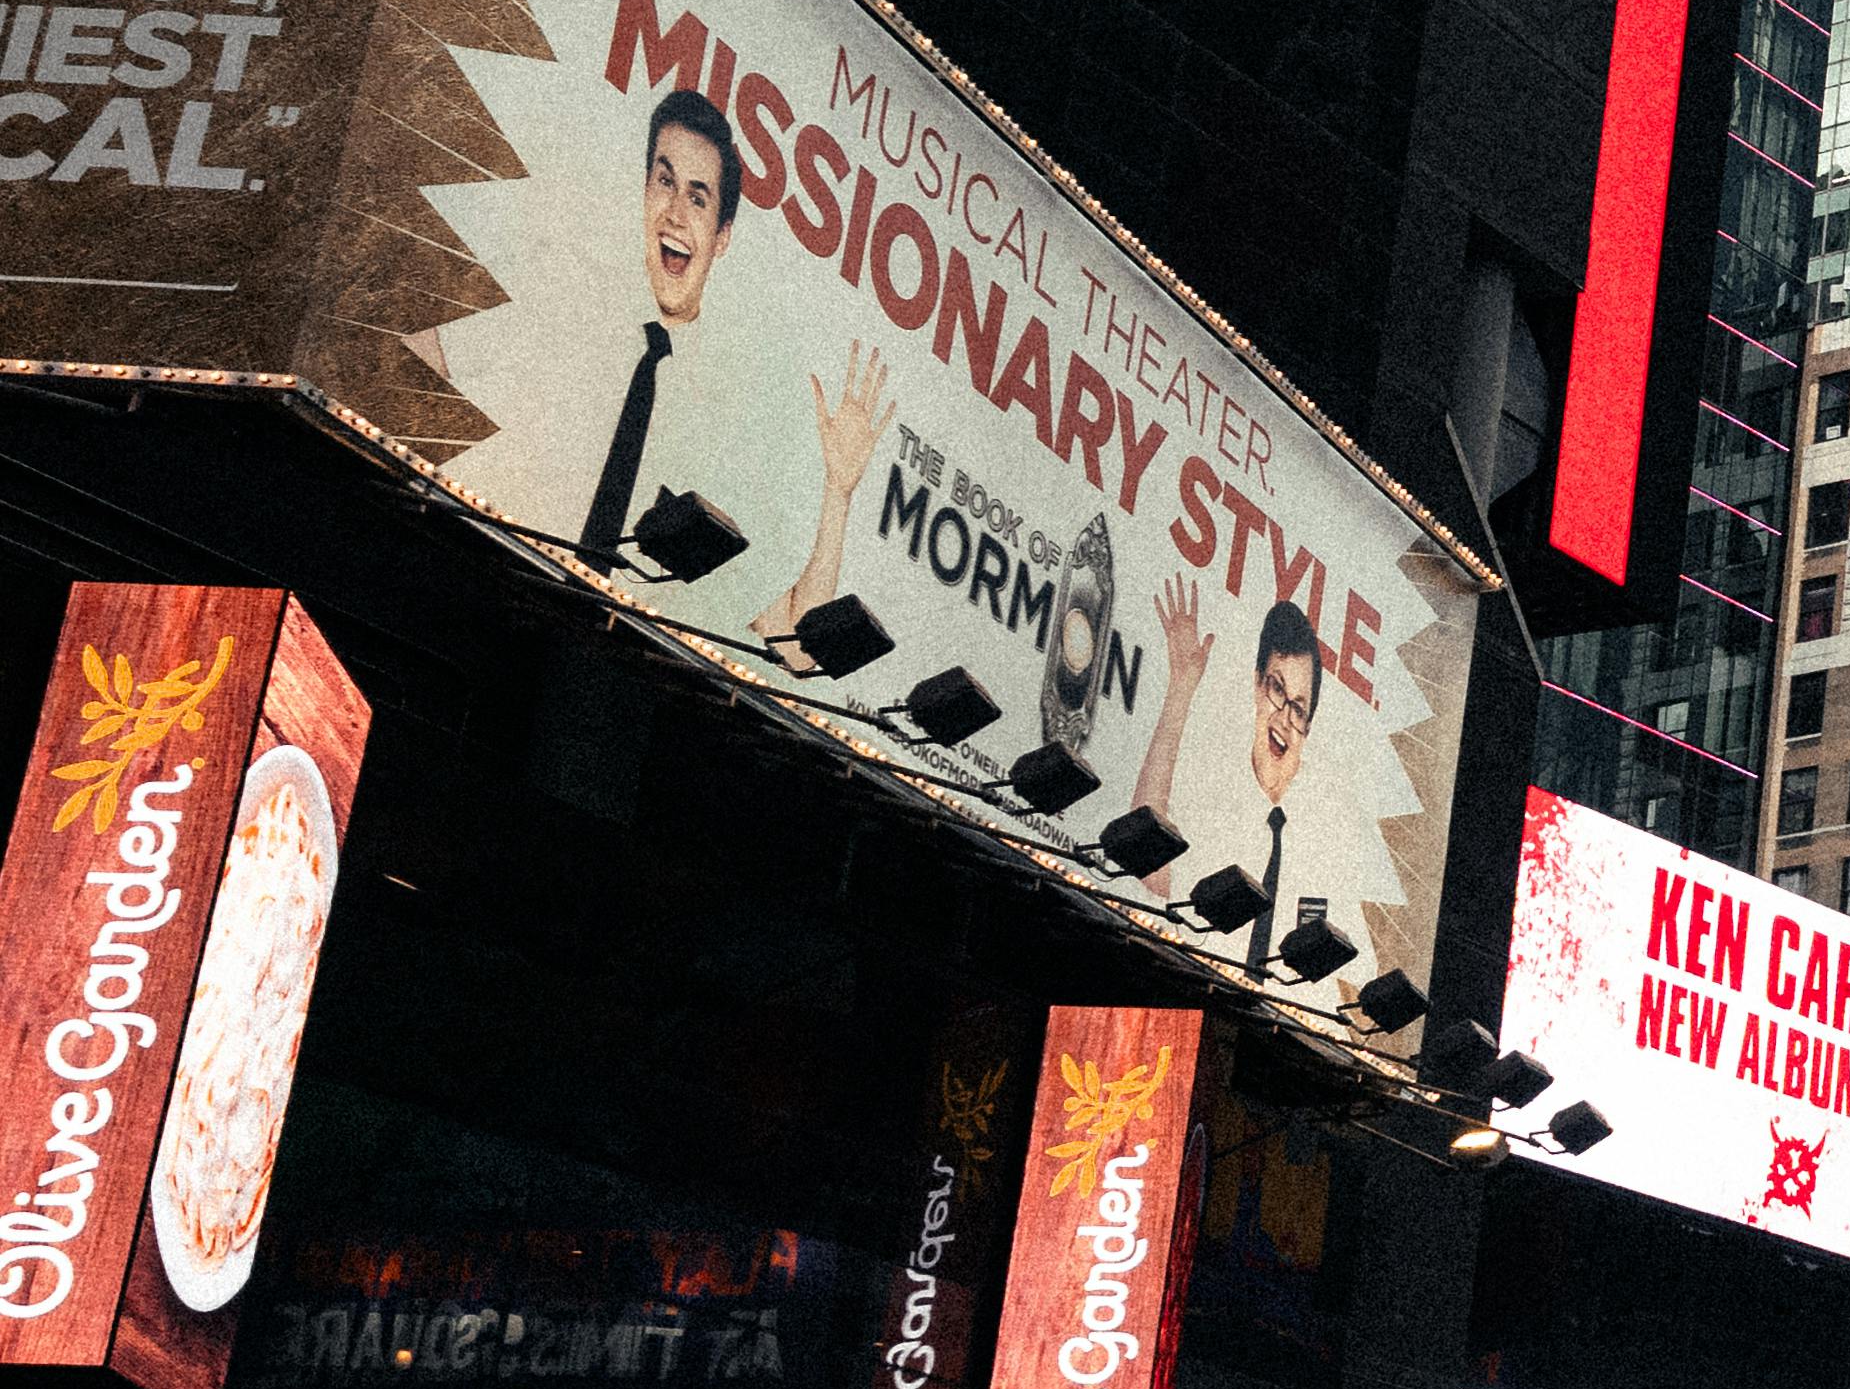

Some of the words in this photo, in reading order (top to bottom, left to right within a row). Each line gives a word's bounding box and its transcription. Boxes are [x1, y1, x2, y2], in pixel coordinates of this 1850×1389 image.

[0, 4, 283, 93] IEST
[830, 45, 1058, 309] MUSICAL
[1082, 266, 1276, 498] THEATER.
[899, 423, 946, 489] THE
[951, 468, 1023, 548] BOOK
[1028, 530, 1062, 571] OF
[46, 762, 195, 1080] Garden
[1646, 866, 1751, 992] KEN
[1635, 975, 1728, 1070] NEW
[0, 1087, 114, 1319] Olive
[1058, 1143, 1150, 1385] Garden
